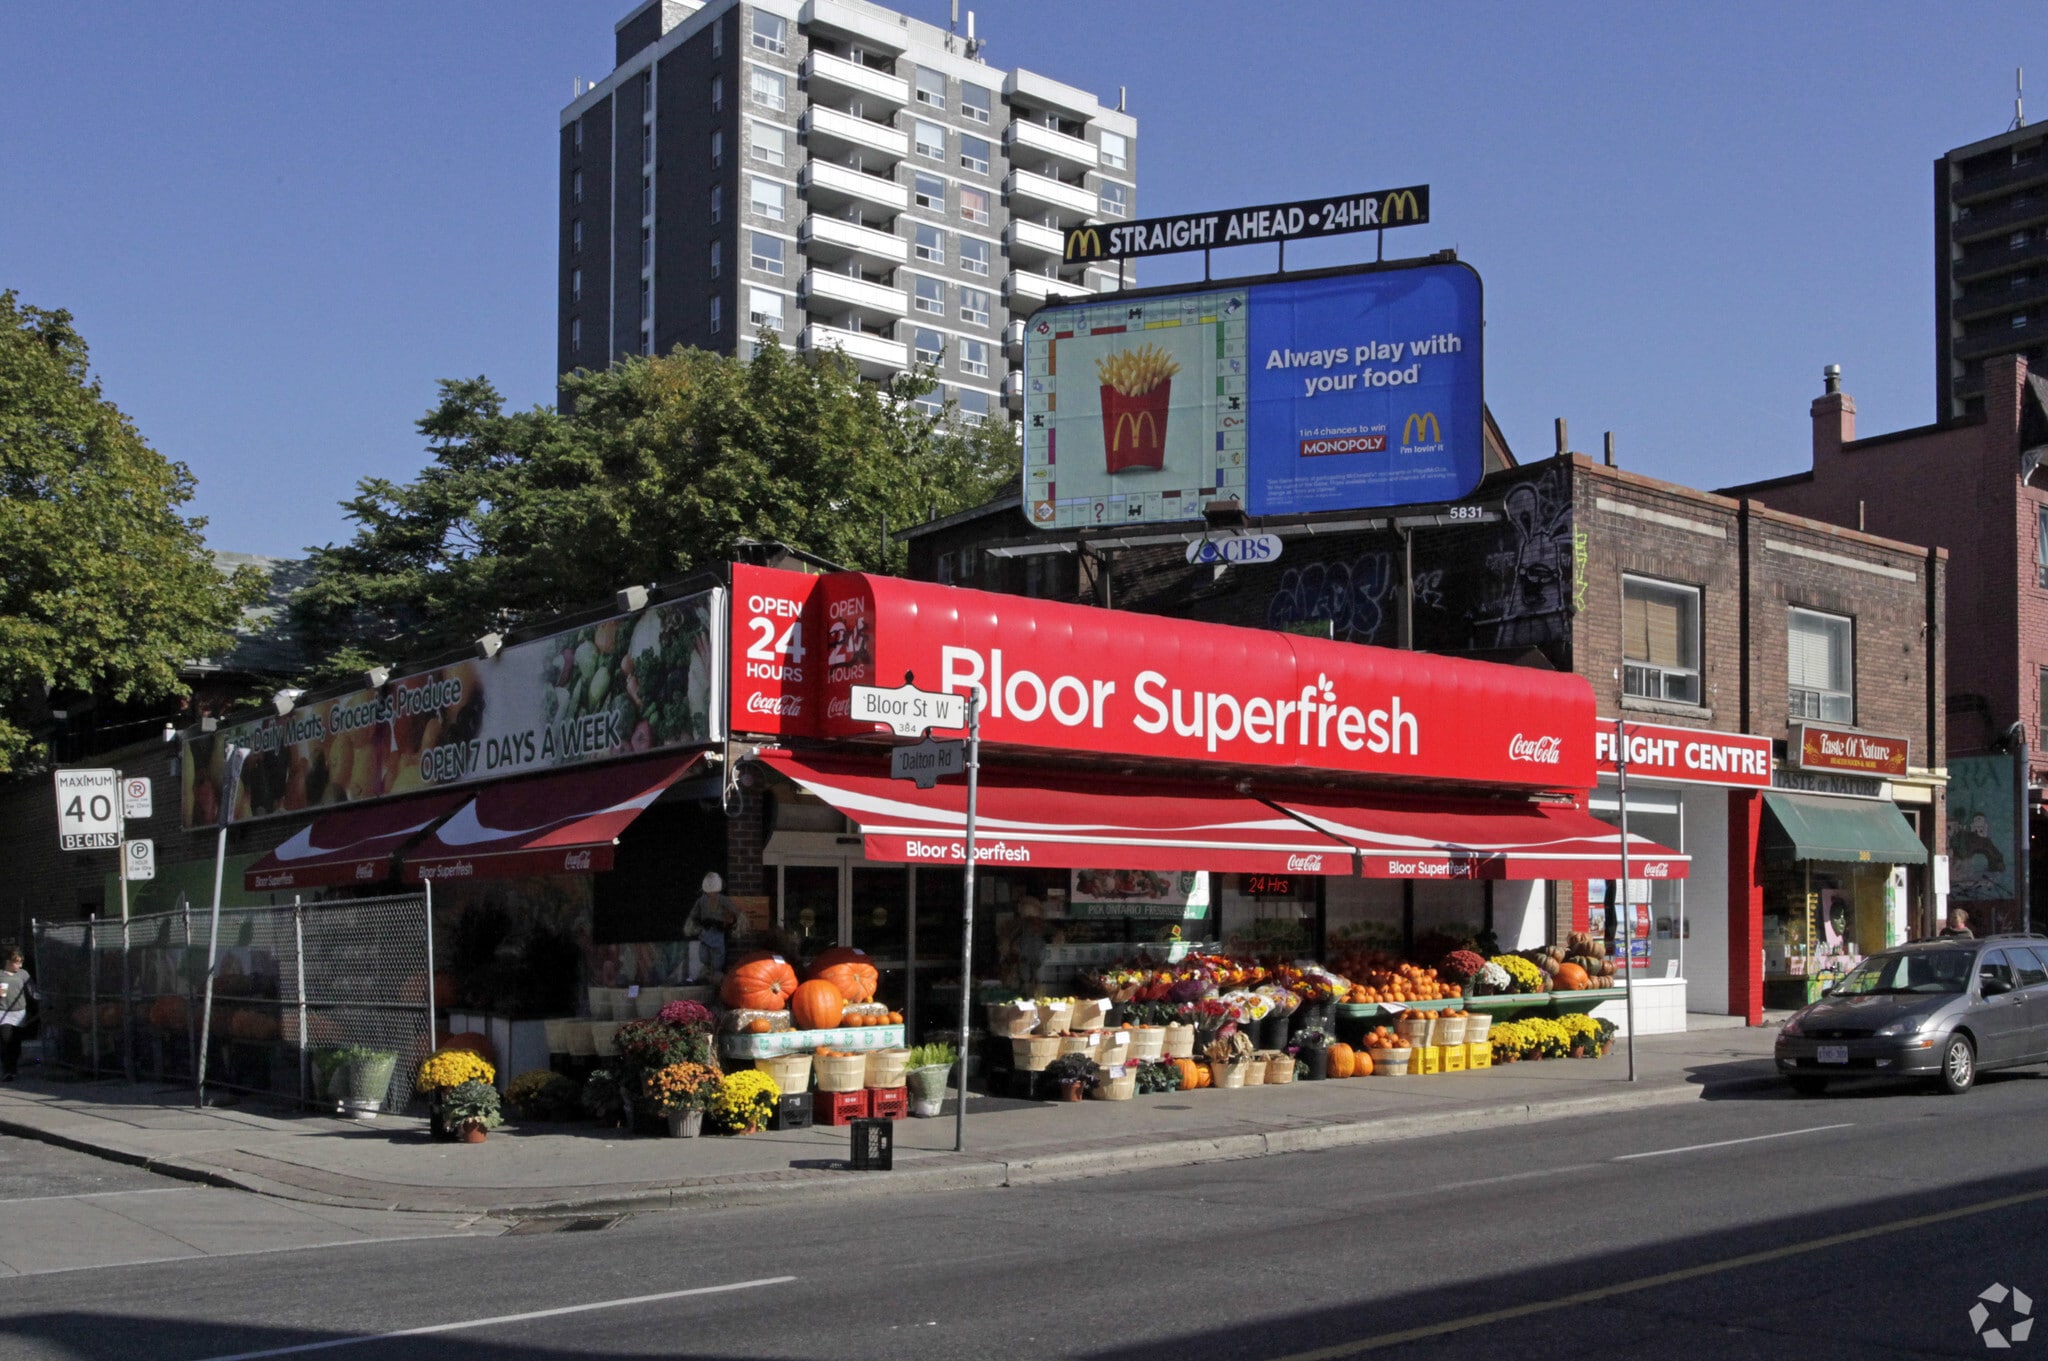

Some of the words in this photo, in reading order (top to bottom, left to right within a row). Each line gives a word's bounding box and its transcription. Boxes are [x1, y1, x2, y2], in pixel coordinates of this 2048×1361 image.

[1109, 216, 1218, 254] STRAIGHT
[1225, 207, 1304, 240] AHEAD
[1322, 198, 1380, 230] 24HR
[1266, 348, 1349, 369] Always
[1355, 341, 1404, 366] play
[1410, 333, 1461, 356] with
[1305, 373, 1357, 397] your
[1314, 428, 1319, 436] 4
[1320, 425, 1357, 435] chances
[1360, 425, 1369, 433] to
[1371, 424, 1386, 433] win
[1303, 438, 1383, 455] MONOPOLY
[1450, 506, 1483, 519] 5831
[1223, 538, 1270, 561] CBS
[748, 595, 802, 617] OPEN
[829, 596, 865, 619] OPEN
[747, 616, 806, 664] 24
[747, 662, 803, 682] HOURS
[827, 664, 865, 684] HOURS
[747, 691, 803, 717] Coca-Cola
[827, 696, 851, 718] Coca-C
[866, 693, 909, 715] Bloor
[913, 699, 928, 718] St
[936, 702, 949, 720] W
[942, 646, 1115, 728] Bloor
[1133, 670, 1419, 756] Superfresh
[254, 719, 284, 756] Daily
[330, 696, 393, 732] Groceries
[397, 676, 462, 716] Produce
[898, 723, 916, 733] 384
[421, 742, 467, 782] OPEN
[470, 740, 482, 773] 7
[487, 729, 535, 770] DAYS
[541, 725, 555, 760] A
[561, 710, 620, 757] WEEK
[1509, 733, 1562, 764] Coca-Cola
[1595, 732, 1679, 767] FLIGHT
[1685, 742, 1767, 775] CENTRE
[1820, 733, 1844, 756] Taste
[1846, 737, 1858, 758] Of
[1859, 738, 1890, 760] Nature
[902, 750, 935, 771] Dalton
[938, 751, 951, 767] Rd
[60, 776, 113, 787] MAXIMUM
[1776, 772, 1816, 791] TASTE
[1830, 776, 1879, 796] NATURE
[65, 795, 112, 822] 40
[66, 833, 115, 848] BEGINS
[906, 840, 947, 858] Bloor
[418, 865, 437, 879] Bloor
[1389, 860, 1416, 874] Bloor
[1248, 877, 1266, 893] 24
[1267, 877, 1289, 893] Hrs
[1088, 905, 1104, 915] PICK
[1106, 905, 1141, 915] ONTARIO
